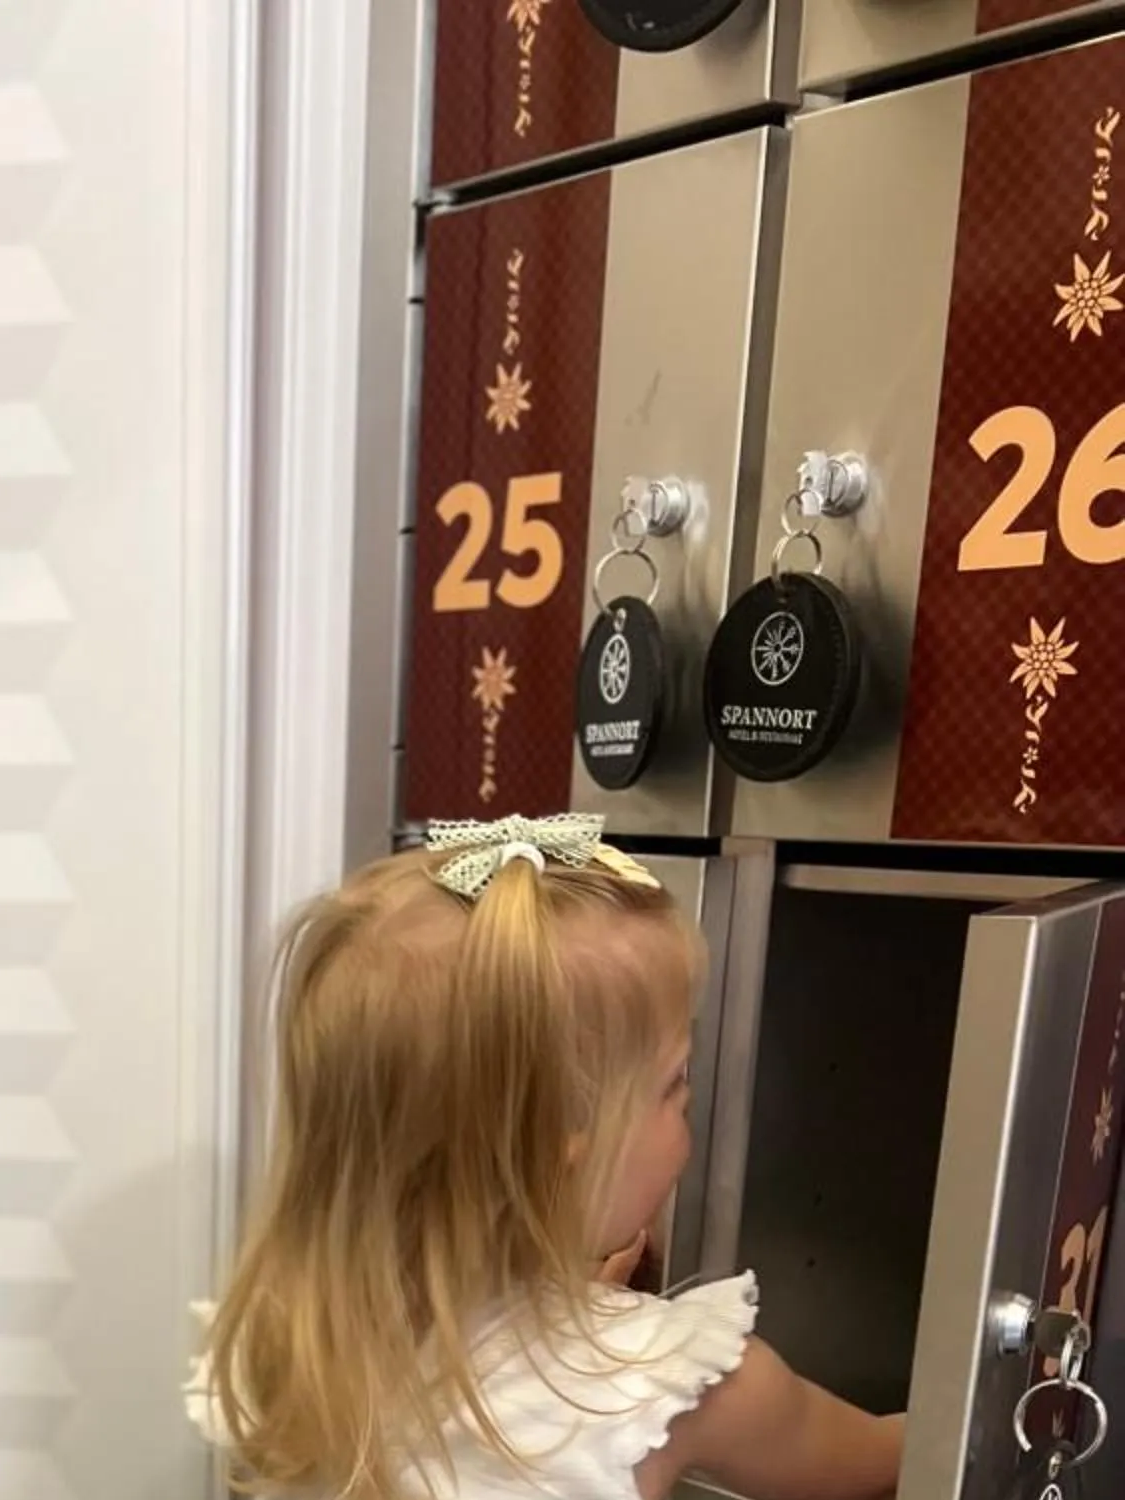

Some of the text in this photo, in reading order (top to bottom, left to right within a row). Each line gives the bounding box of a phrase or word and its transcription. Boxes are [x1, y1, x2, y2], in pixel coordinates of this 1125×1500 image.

[432, 471, 563, 613] 25
[957, 402, 1125, 571] 26
[721, 705, 817, 729] SPANNORT
